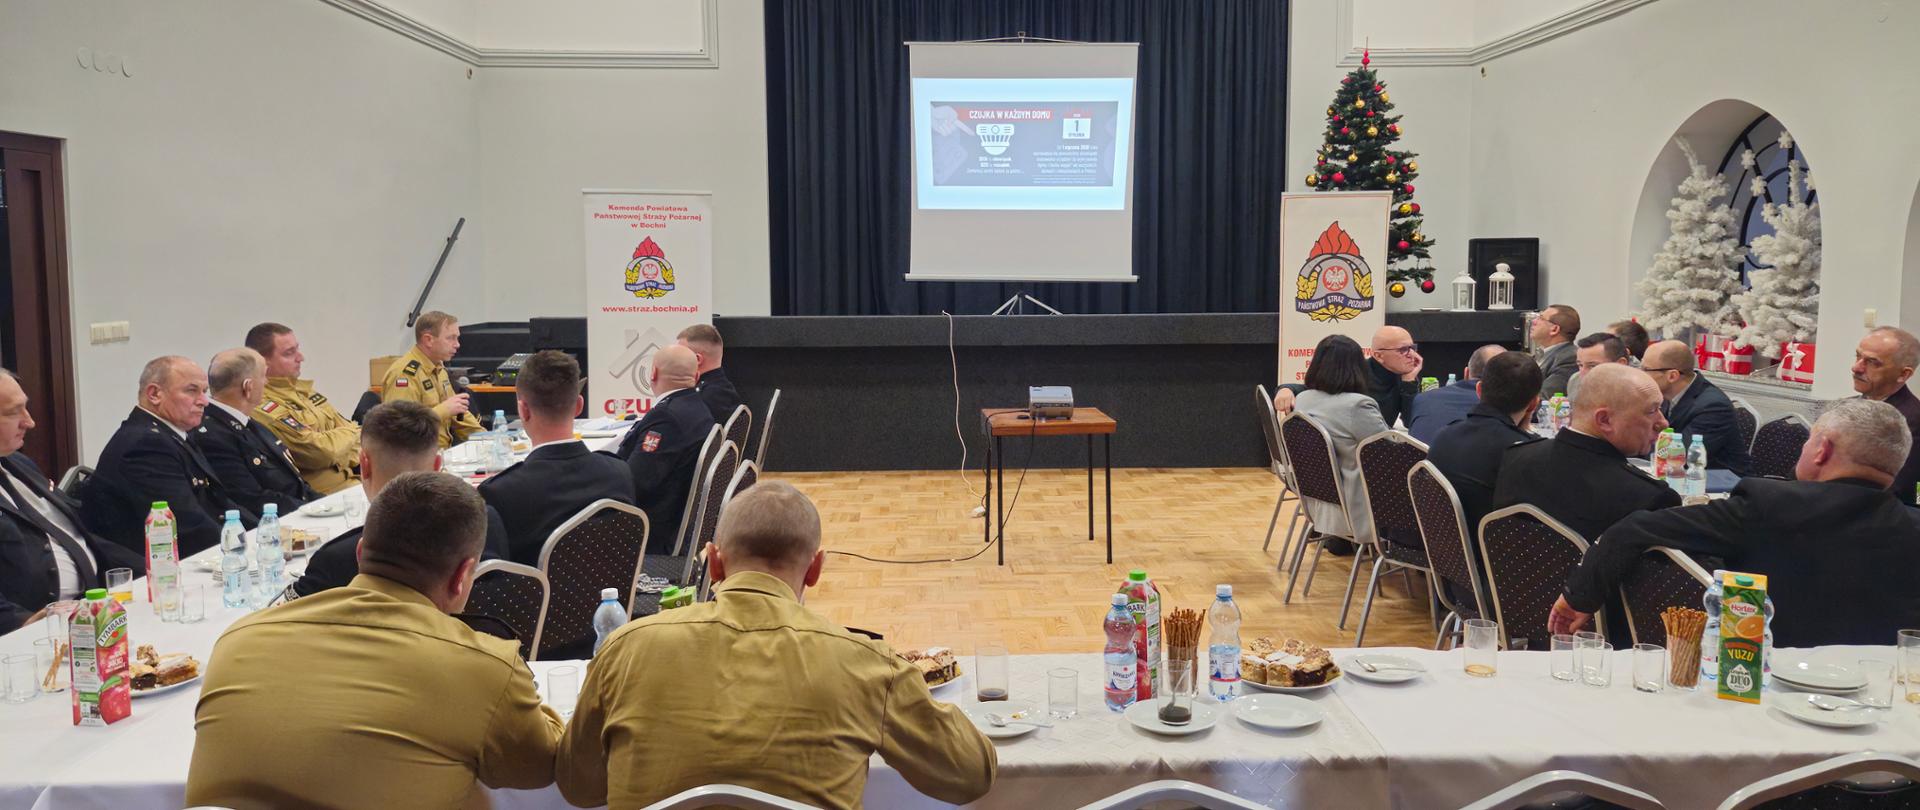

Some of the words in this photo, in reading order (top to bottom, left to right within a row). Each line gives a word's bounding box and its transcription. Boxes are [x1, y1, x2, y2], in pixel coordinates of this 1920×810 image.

[969, 110, 995, 119] CZUJKA
[997, 110, 1004, 119] W
[1004, 109, 1031, 119] KAŻDYM
[1031, 110, 1051, 119] DOMU
[1074, 120, 1079, 132] 1
[602, 305, 698, 313] www.straz.bochnia.pl
[1288, 348, 1316, 357] KOMEN
[98, 613, 128, 643] TYMBARK
[1727, 648, 1755, 662] YUZU
[1730, 674, 1751, 686] DUO
